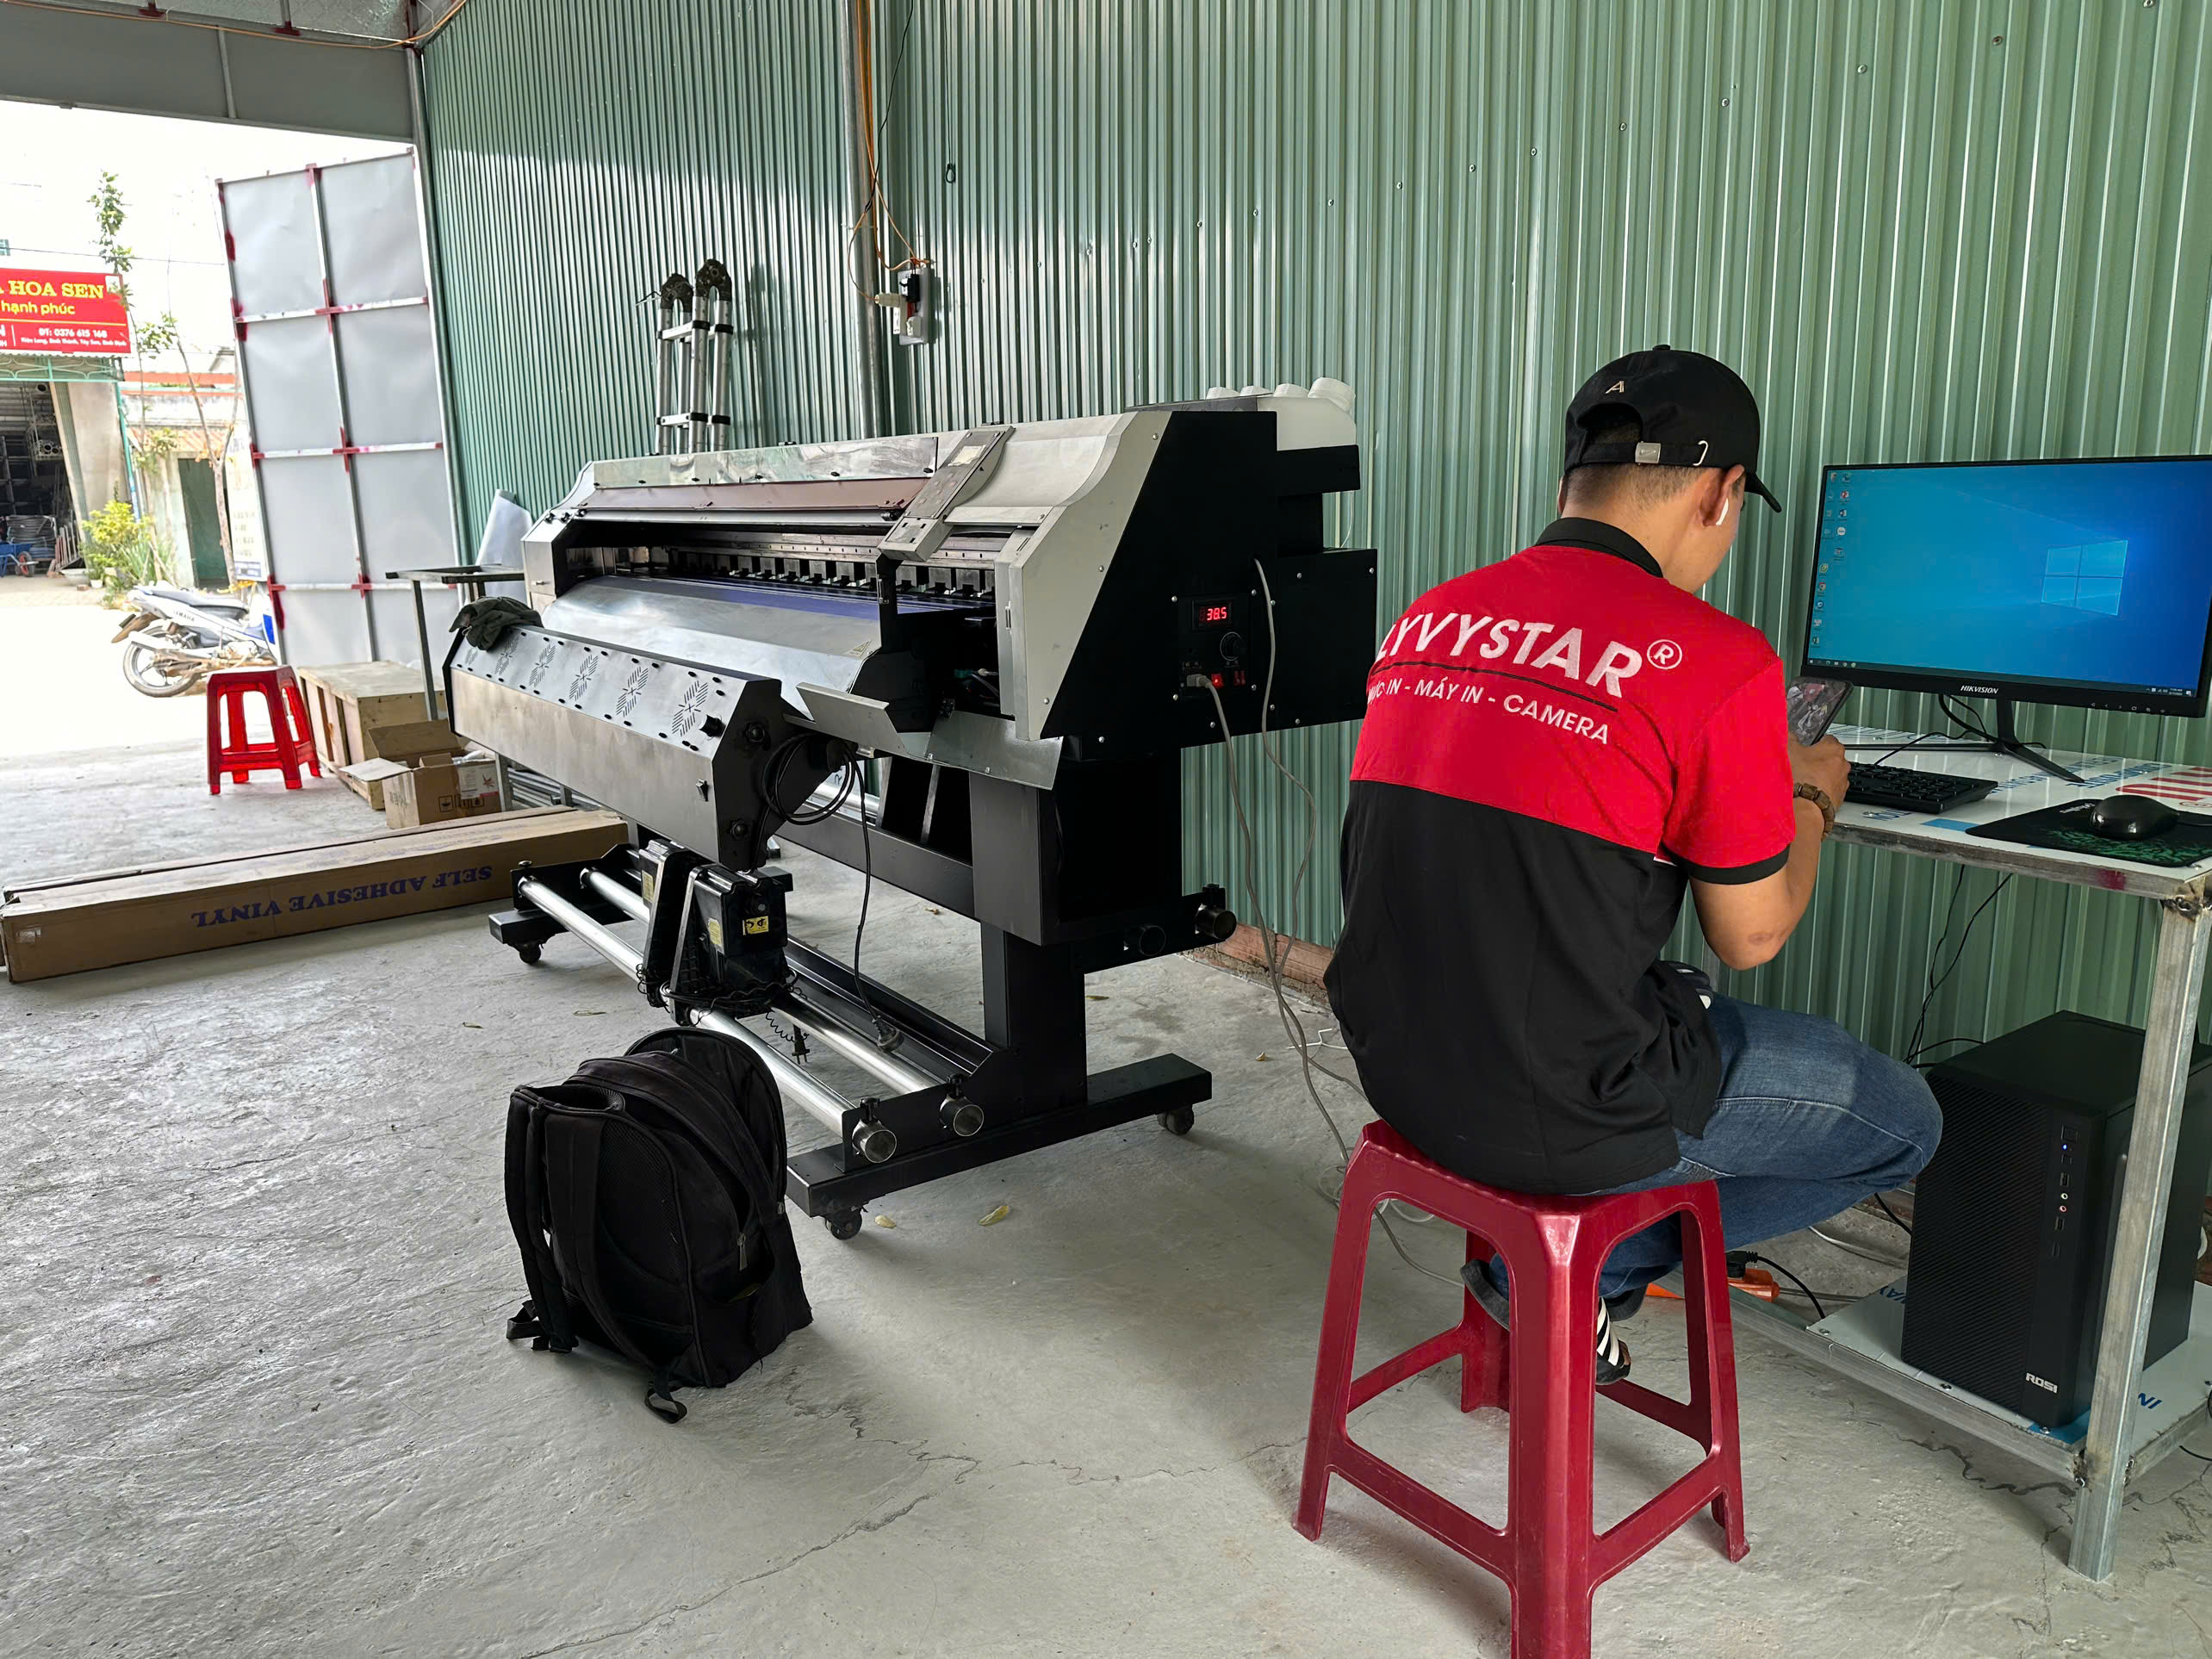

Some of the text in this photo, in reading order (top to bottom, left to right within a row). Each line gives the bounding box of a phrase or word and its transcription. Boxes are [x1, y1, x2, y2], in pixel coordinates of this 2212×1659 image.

[8, 280, 58, 296] HOA
[61, 283, 104, 299] SEN
[1, 300, 76, 315] hạnh phúc
[1960, 685, 1998, 694] HIKVISION
[1386, 678, 1403, 695] IN
[1414, 676, 1460, 700] MÁY
[1460, 685, 1484, 704] IN
[1503, 694, 1608, 744] CAMERA
[190, 865, 493, 928] SELF ADHESIVE VINYL
[2025, 1372, 2058, 1394] ROSI
